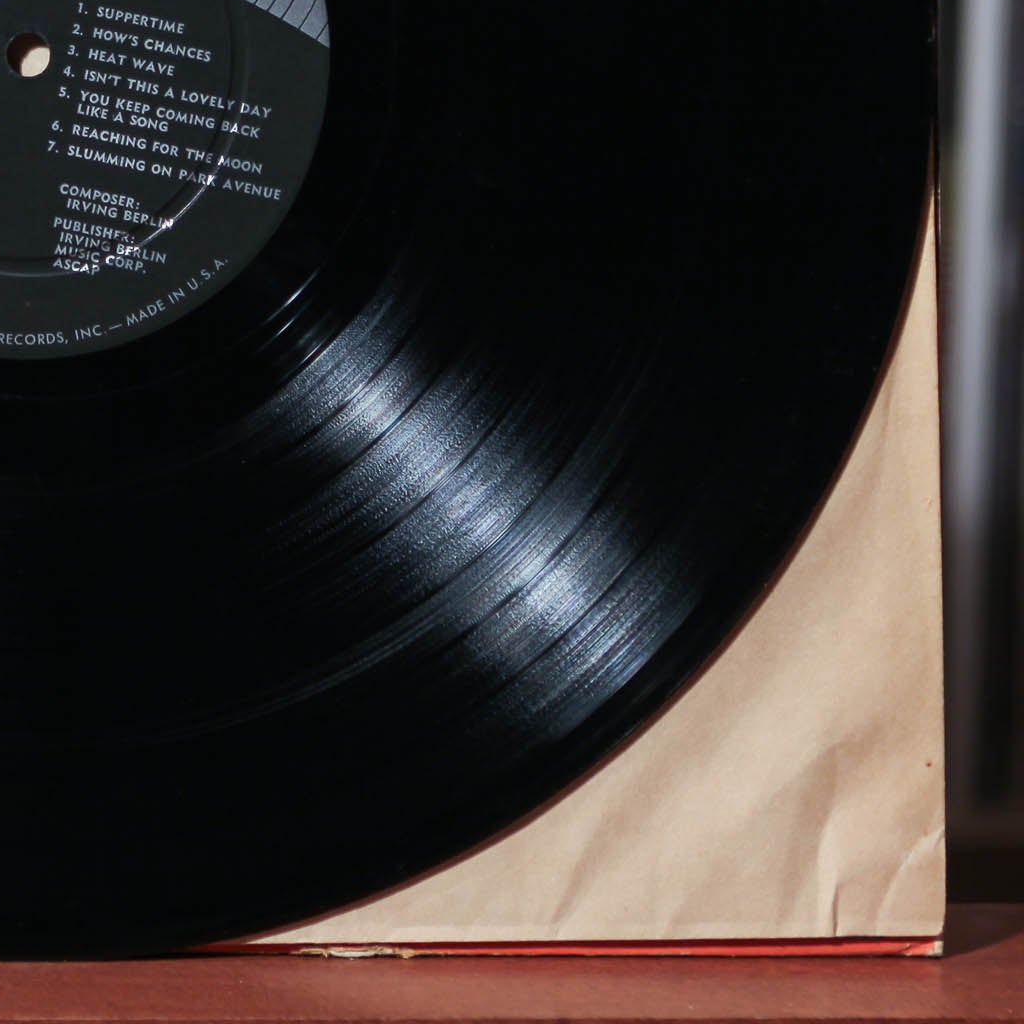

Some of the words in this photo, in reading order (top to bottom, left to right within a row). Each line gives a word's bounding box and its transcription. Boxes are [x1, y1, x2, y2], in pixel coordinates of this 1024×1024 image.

[77, 2, 88, 16] 1.
[96, 5, 185, 34] SUPPERTIME
[72, 23, 84, 37] 2.
[92, 27, 139, 48] HOW'S
[143, 39, 212, 63] CHANCES
[67, 44, 79, 58] 3.
[88, 48, 127, 67] HEAT
[132, 57, 176, 77] WAVE
[63, 65, 75, 78] 4.
[84, 69, 122, 88] ISN'T
[127, 77, 159, 96] THIS
[164, 86, 175, 99] A
[180, 90, 236, 111] LOVELY
[240, 102, 273, 120] DAY
[58, 86, 70, 99] 5.
[79, 90, 110, 106] YOU
[115, 98, 151, 115] KEEP
[156, 106, 216, 129] COMING
[221, 120, 261, 139] BACK
[77, 104, 108, 120] LIKE
[113, 111, 124, 124] A
[129, 115, 169, 133] SONG
[51, 120, 63, 133] 6.
[72, 125, 147, 150] REACHING
[152, 141, 179, 157] FOR
[185, 147, 214, 164] THE
[217, 154, 263, 175] MOON
[47, 141, 59, 154] 7.
[67, 145, 146, 173] SLUMMING
[151, 163, 172, 177] ON
[178, 169, 217, 186] PARK
[222, 178, 282, 200] AVENUE
[59, 183, 141, 210] COMPOSER:
[66, 198, 118, 219] IRVING
[123, 209, 174, 230] BERLIN
[54, 244, 100, 264] MUSIC
[104, 254, 148, 275] CORP.
[59, 231, 111, 253] IRVING
[116, 243, 168, 265] BERLIN
[53, 257, 101, 276] ASCAP
[126, 299, 167, 326] MADE
[167, 287, 185, 305] IN
